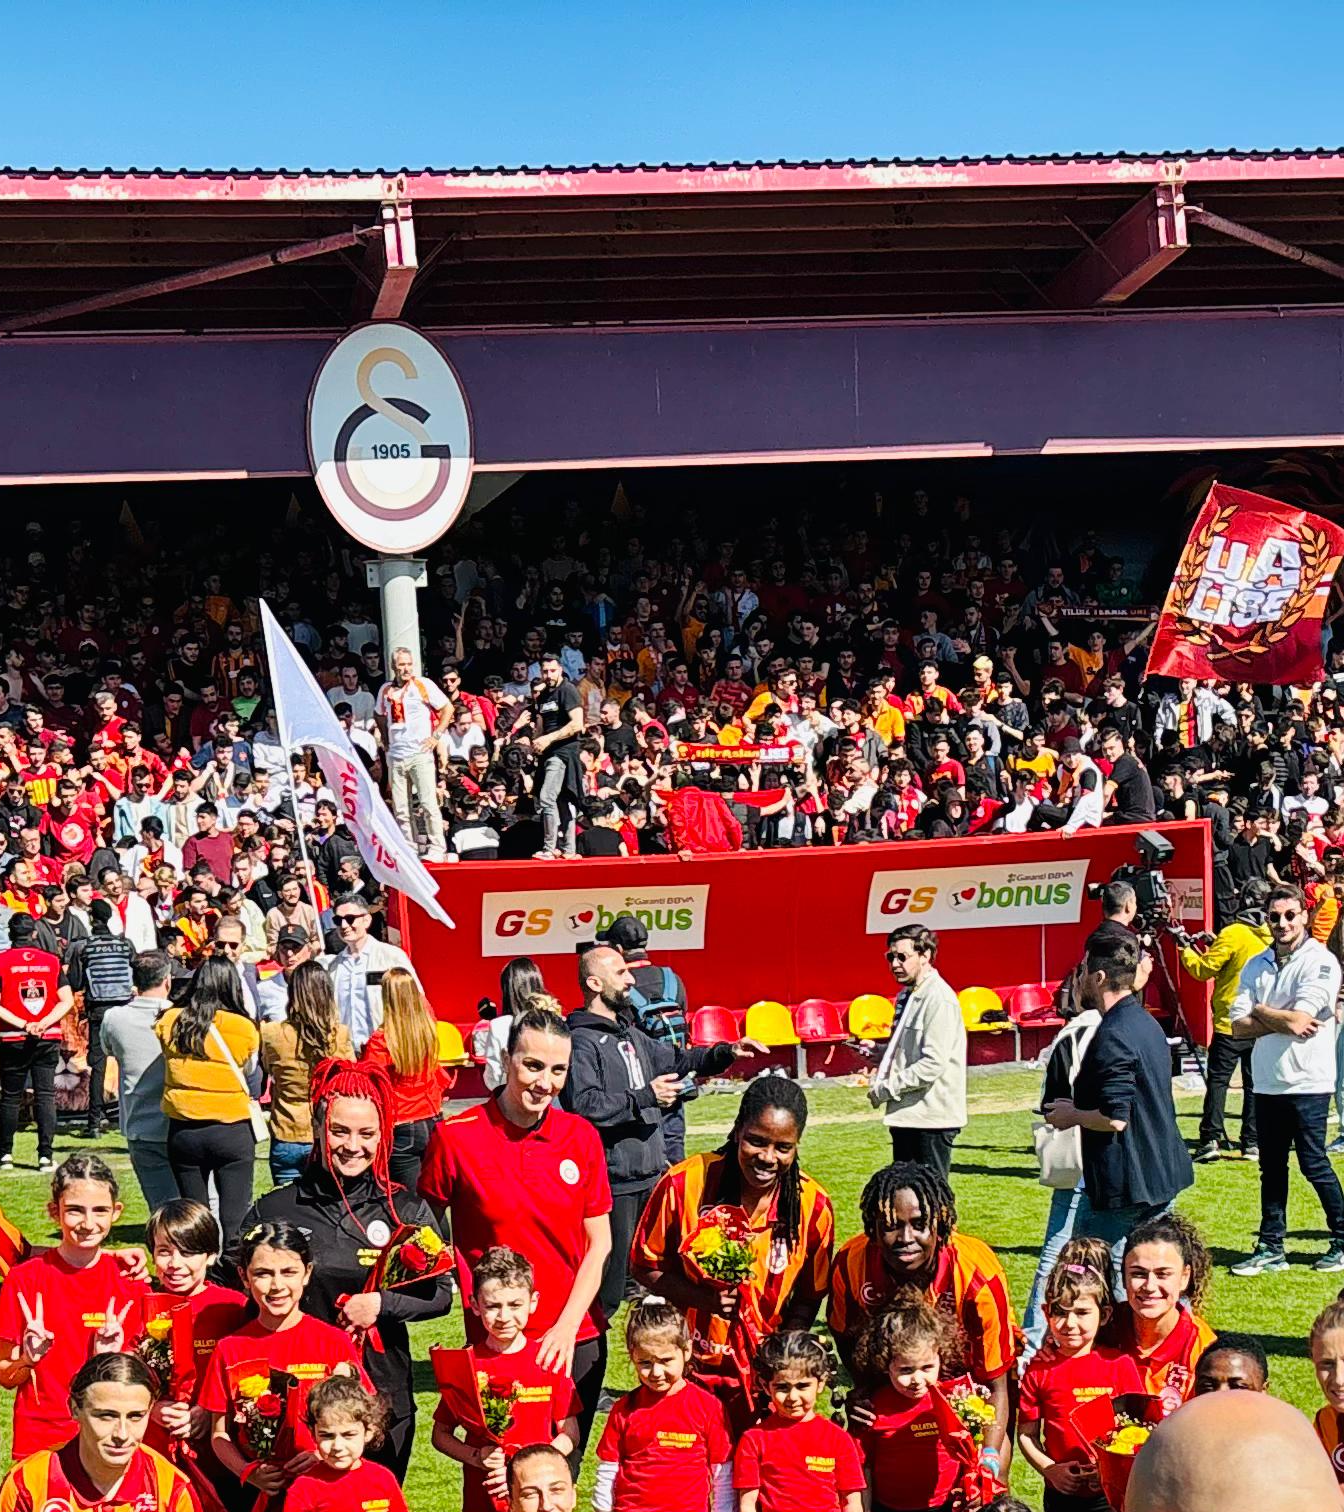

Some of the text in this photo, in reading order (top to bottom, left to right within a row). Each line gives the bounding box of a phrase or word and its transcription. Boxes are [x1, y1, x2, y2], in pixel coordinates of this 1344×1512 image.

[370, 443, 411, 459] 1905
[634, 895, 694, 906] Garanti BBVA
[879, 886, 938, 915] GS
[977, 881, 1072, 909] bonus
[495, 908, 554, 937] GS
